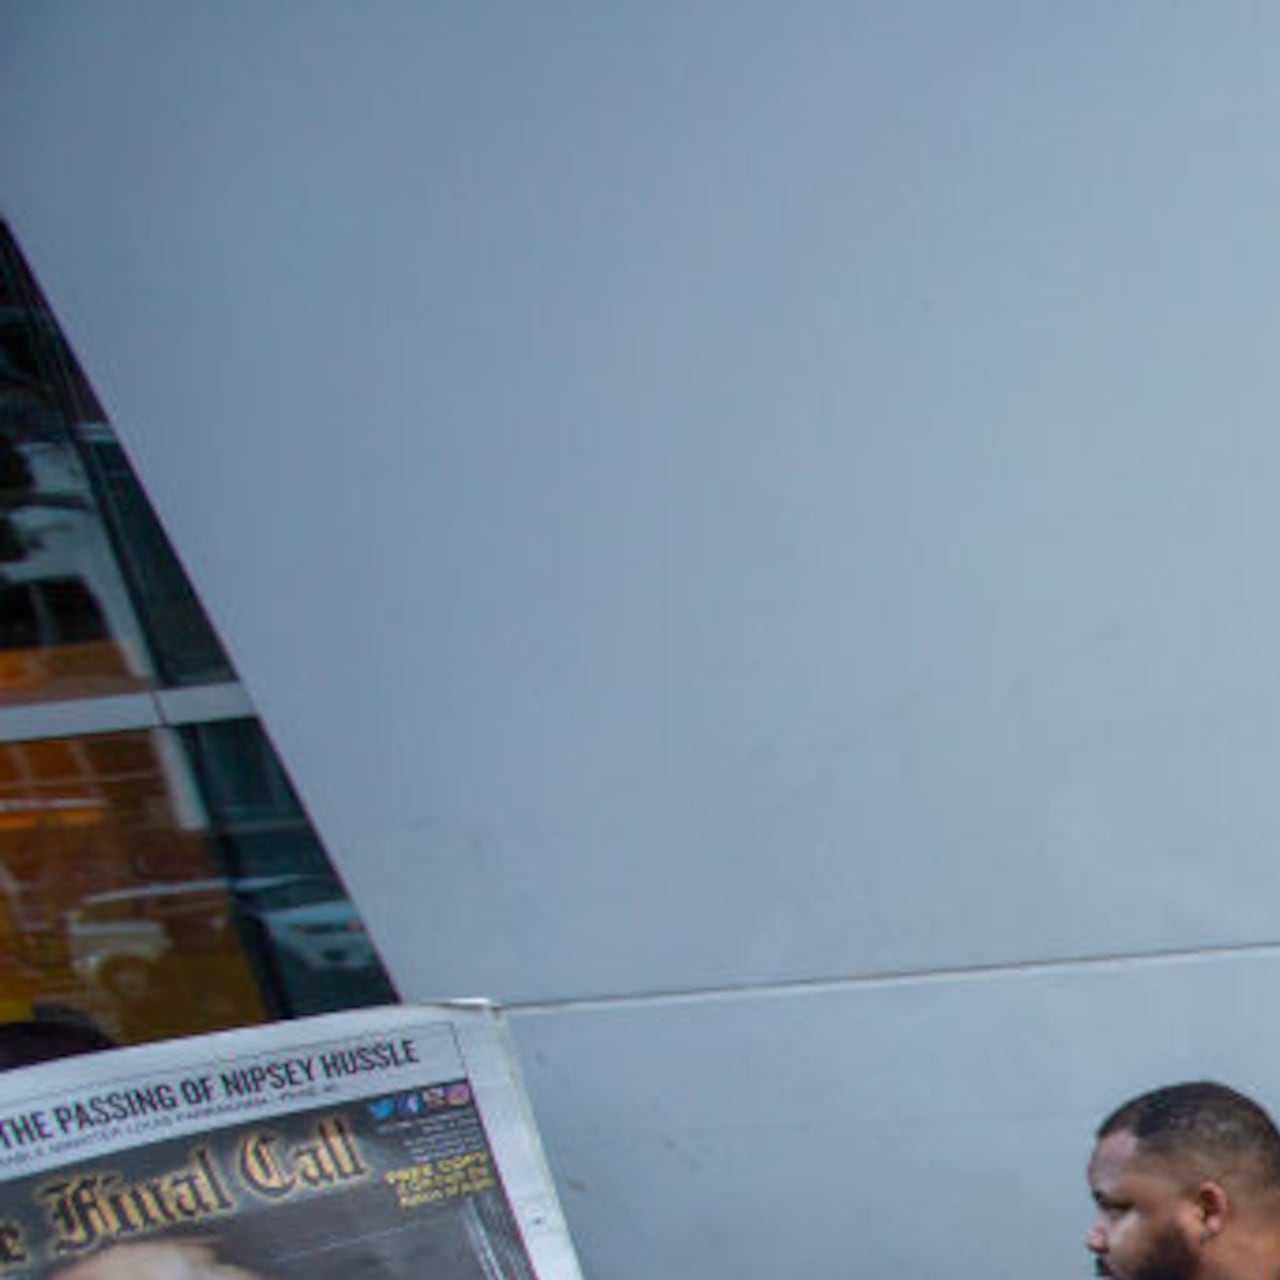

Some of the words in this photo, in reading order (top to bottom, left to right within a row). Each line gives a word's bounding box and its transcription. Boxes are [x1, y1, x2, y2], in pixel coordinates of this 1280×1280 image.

[0, 1110, 53, 1150] THE
[54, 1082, 179, 1135] PASSING
[180, 1076, 216, 1106] OF
[219, 1056, 318, 1100] NIPSEY
[319, 1038, 422, 1080] HUSSLE
[43, 1147, 236, 1257] Final
[240, 1115, 367, 1197] Call
